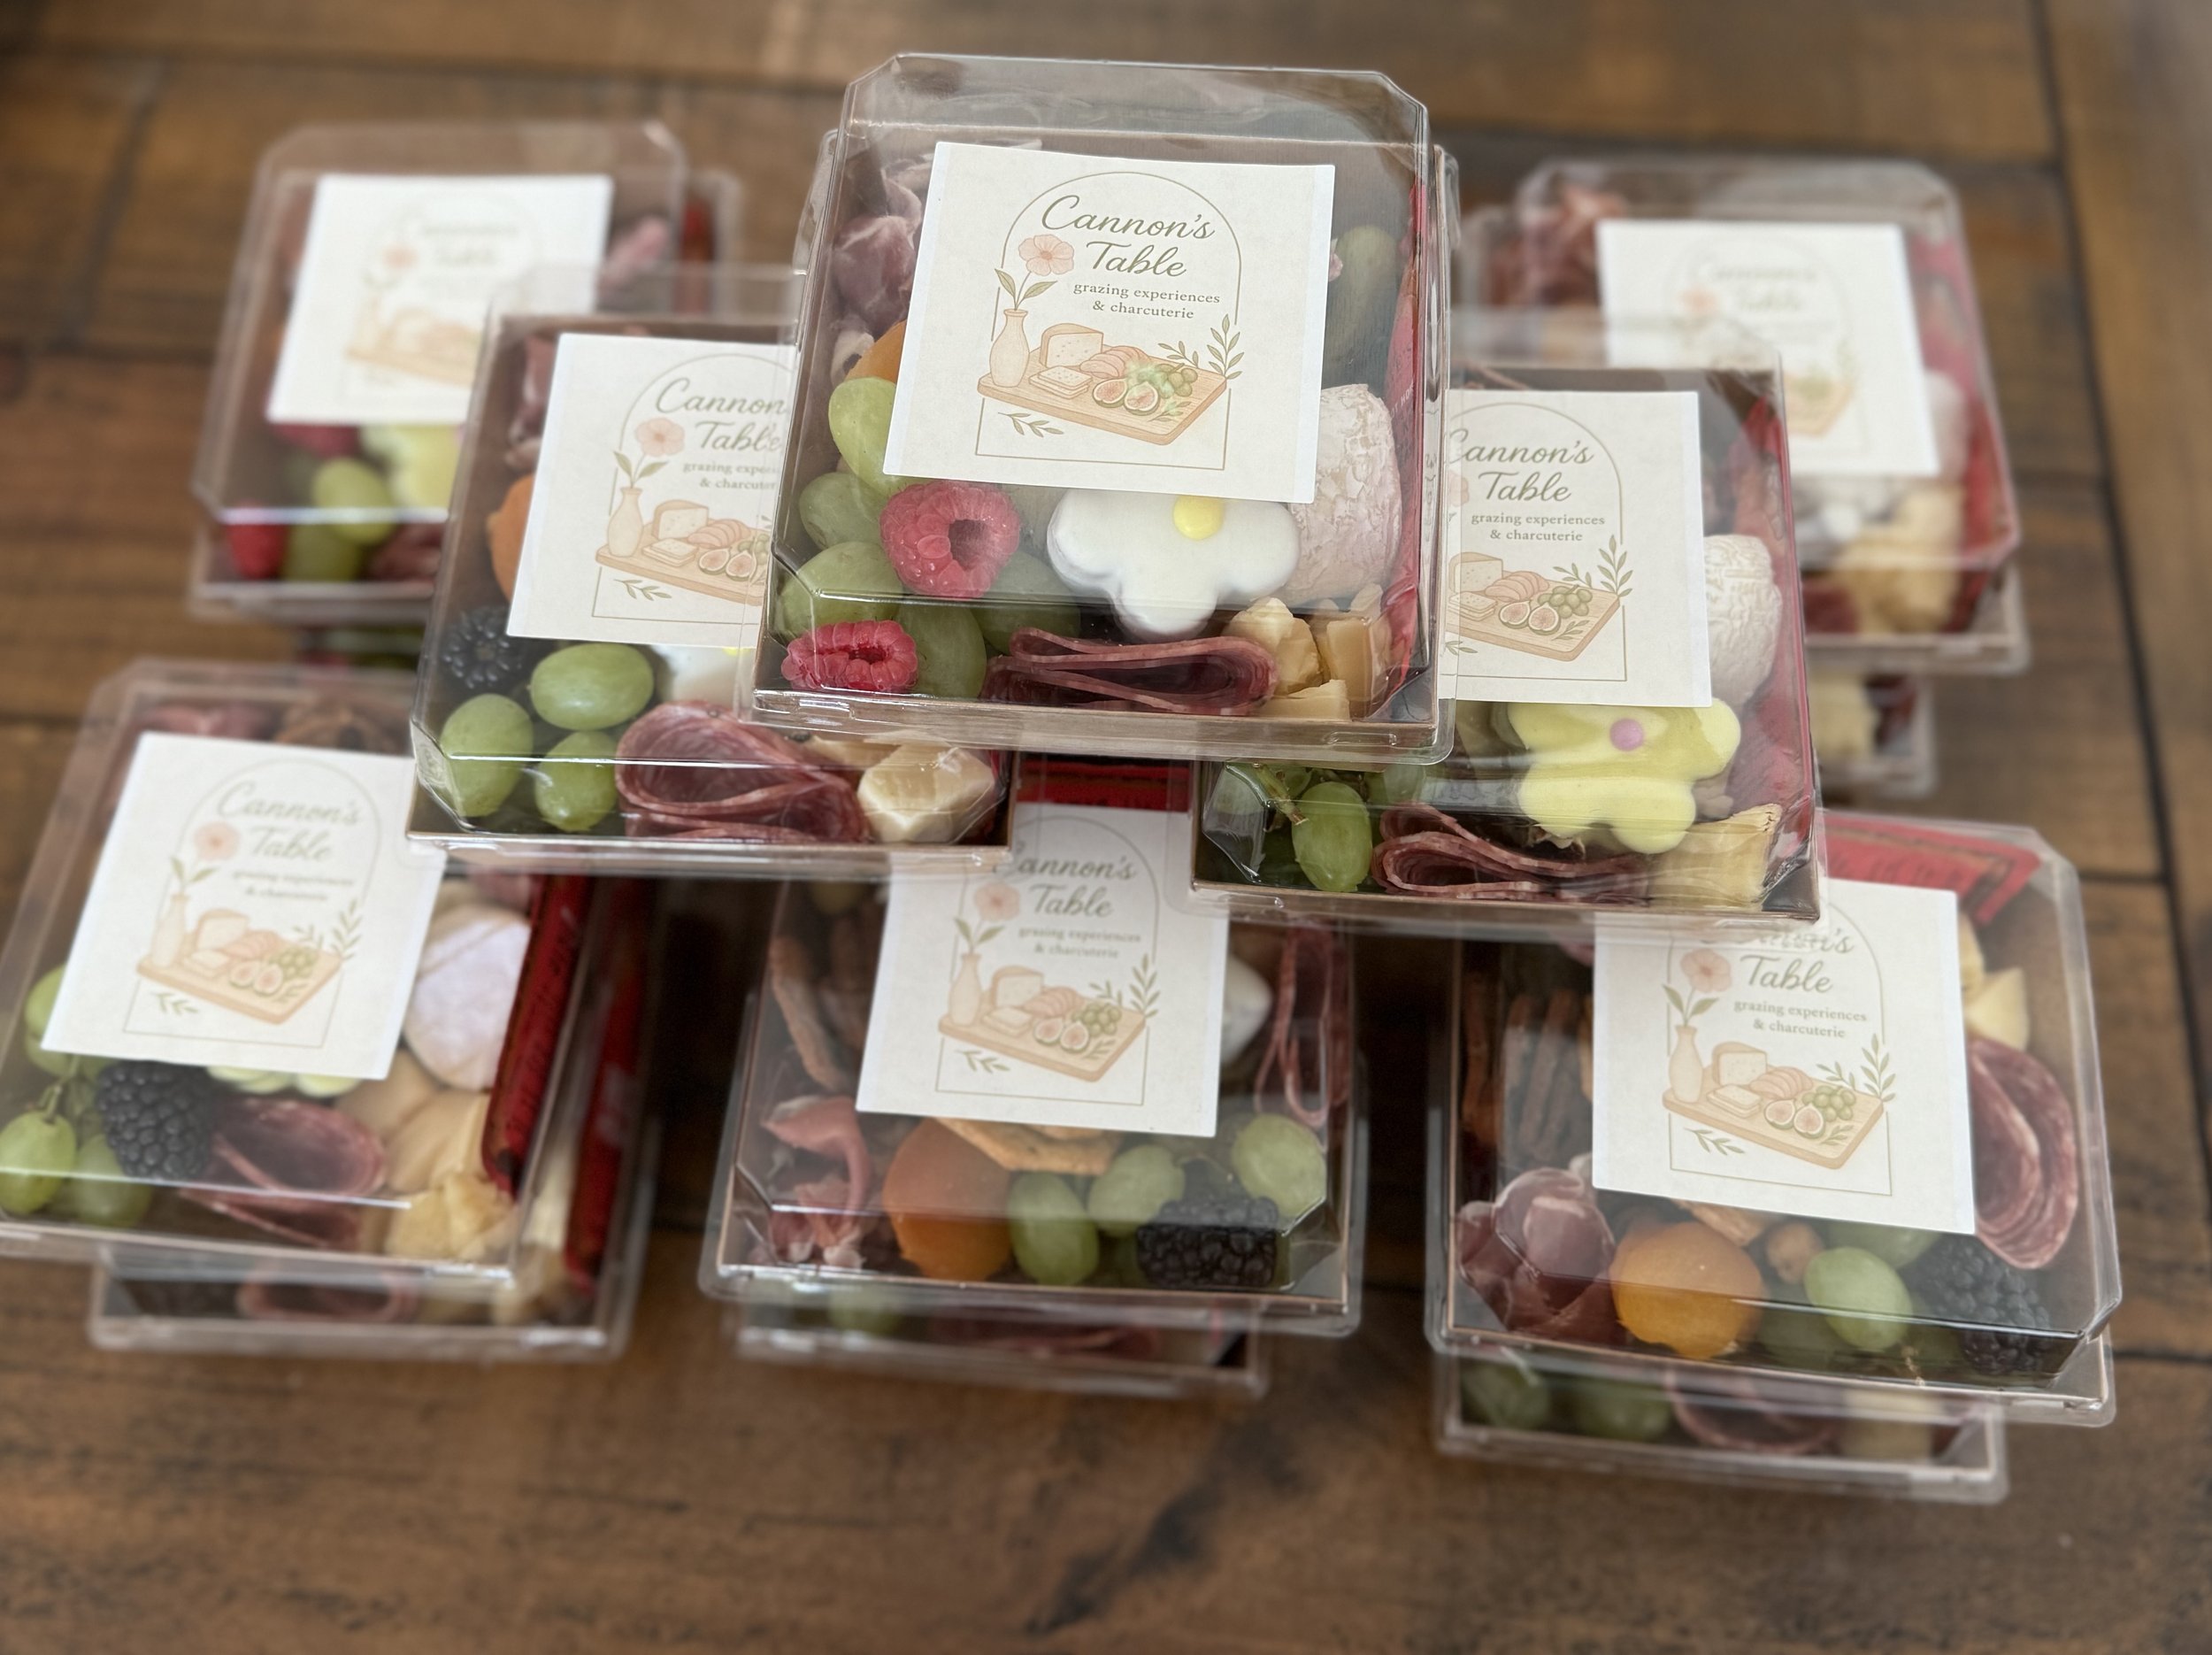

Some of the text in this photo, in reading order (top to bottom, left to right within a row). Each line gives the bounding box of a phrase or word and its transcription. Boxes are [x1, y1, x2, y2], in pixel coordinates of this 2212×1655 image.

[1041, 195, 1216, 239] Cannon's
[1086, 241, 1187, 277] Table
[1072, 282, 1220, 304] grazing experiences
[1092, 300, 1194, 319] & charcuterie
[656, 377, 787, 414] Cannon
[683, 461, 733, 475] grazing
[700, 477, 710, 489] &
[1478, 471, 1572, 502] Table
[1471, 512, 1606, 527] grazing experiences
[1490, 529, 1584, 542] & charcuterie
[250, 824, 333, 862] Table
[1014, 840, 1136, 881] annon's
[1028, 883, 1114, 918] Table
[1740, 953, 1833, 994] Table
[1733, 999, 1867, 1022] grazing experiences
[1753, 1018, 1846, 1038] & charcuterie
